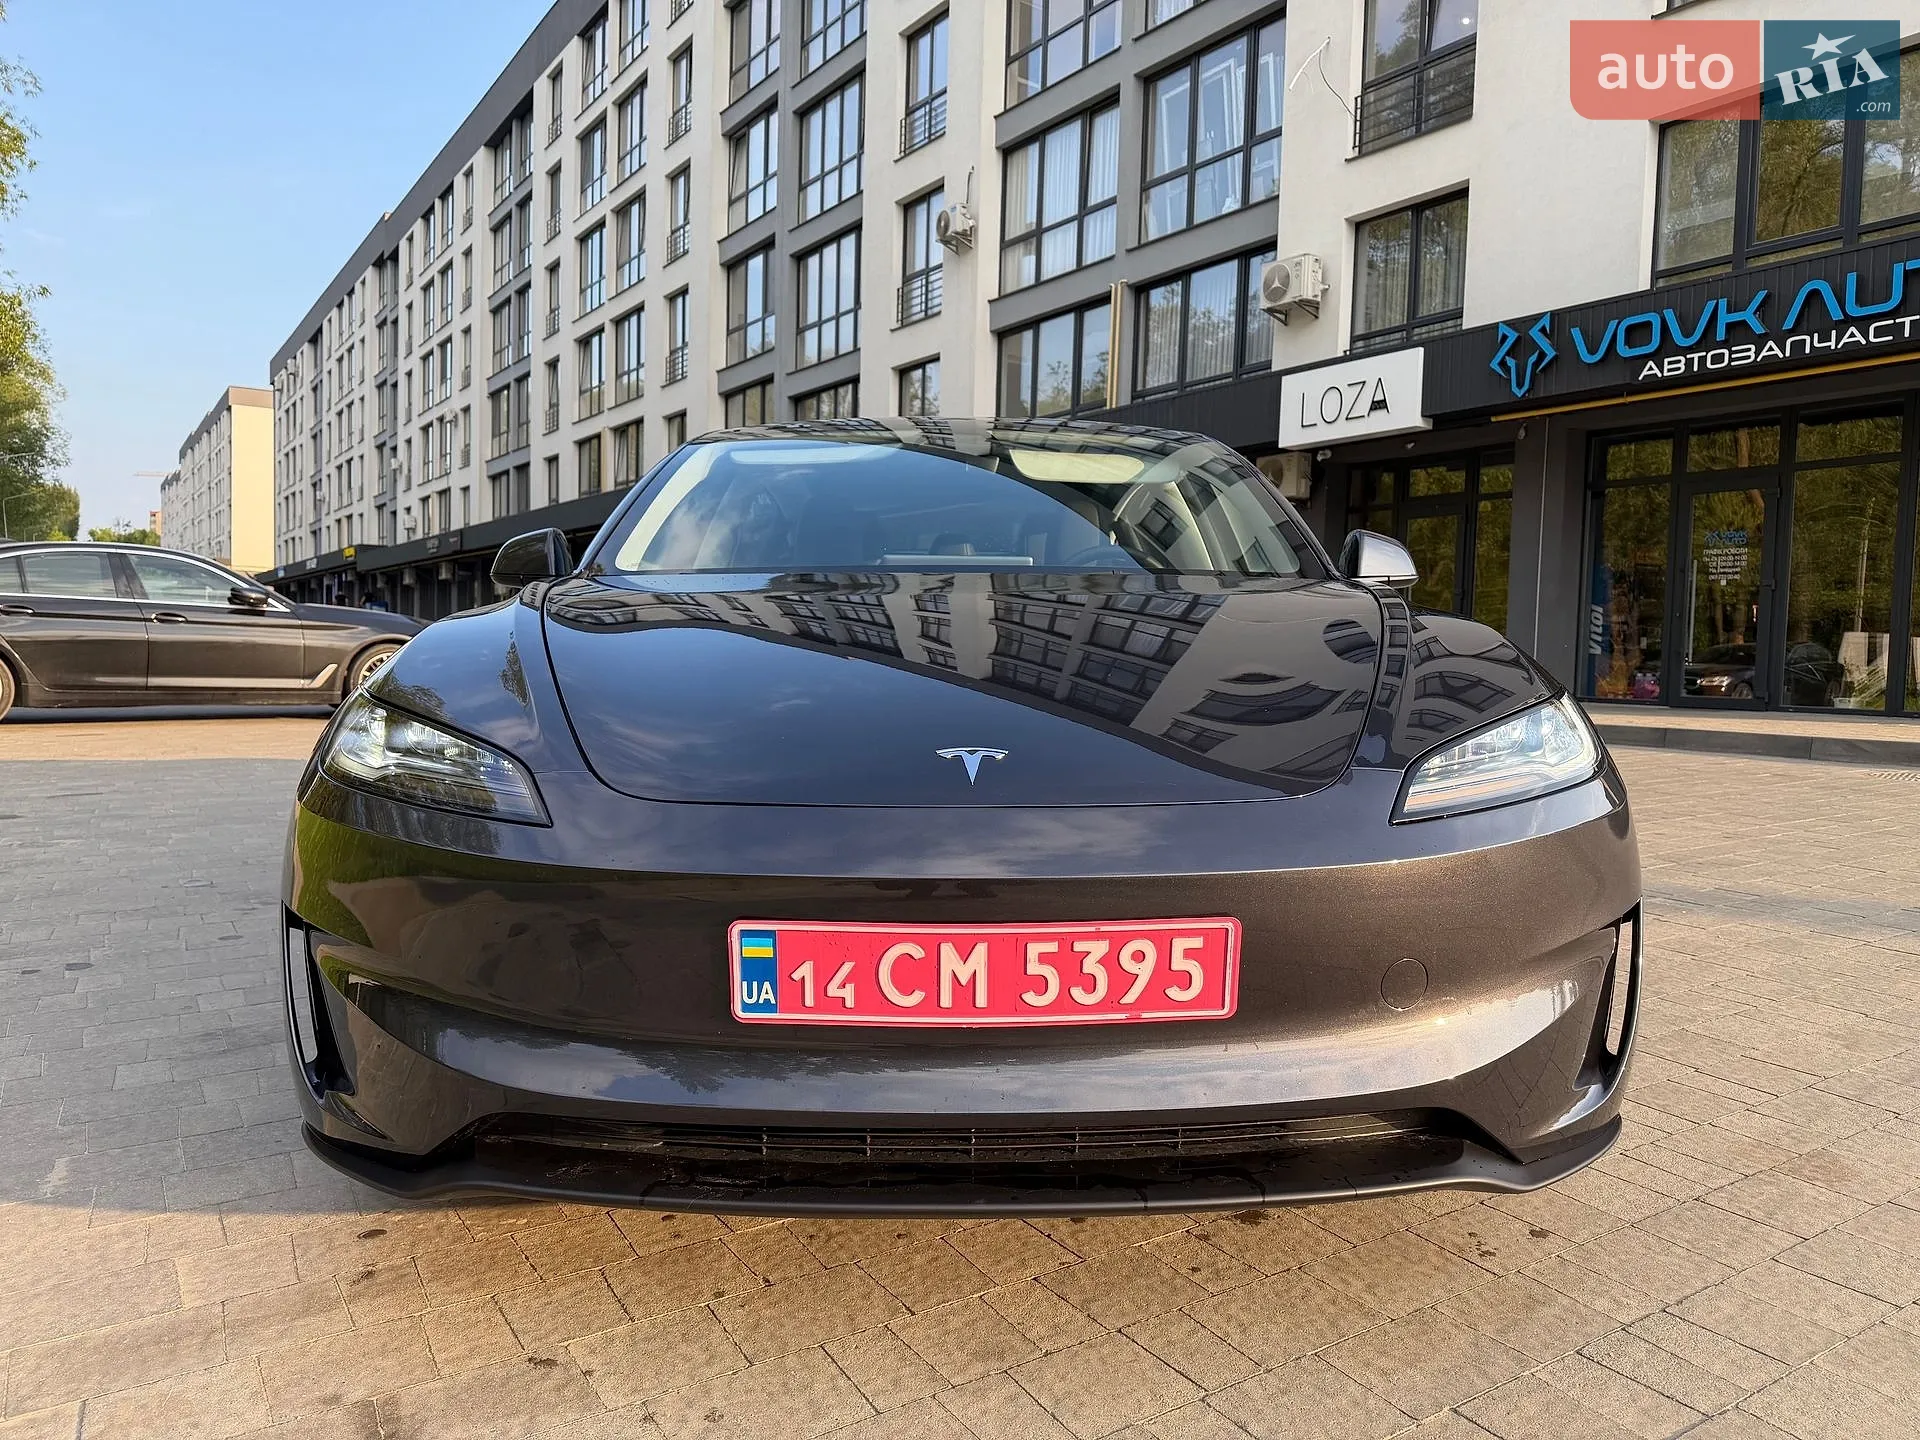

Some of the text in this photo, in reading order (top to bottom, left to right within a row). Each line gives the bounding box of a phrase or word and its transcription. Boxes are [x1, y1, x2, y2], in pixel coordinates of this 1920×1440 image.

[1570, 259, 1920, 364] VOVK AU
[1638, 315, 1920, 380] АВТОЗАПЧАСТ
[1301, 377, 1390, 428] LOZA
[742, 936, 1204, 1008] UA 14 CM 5395
